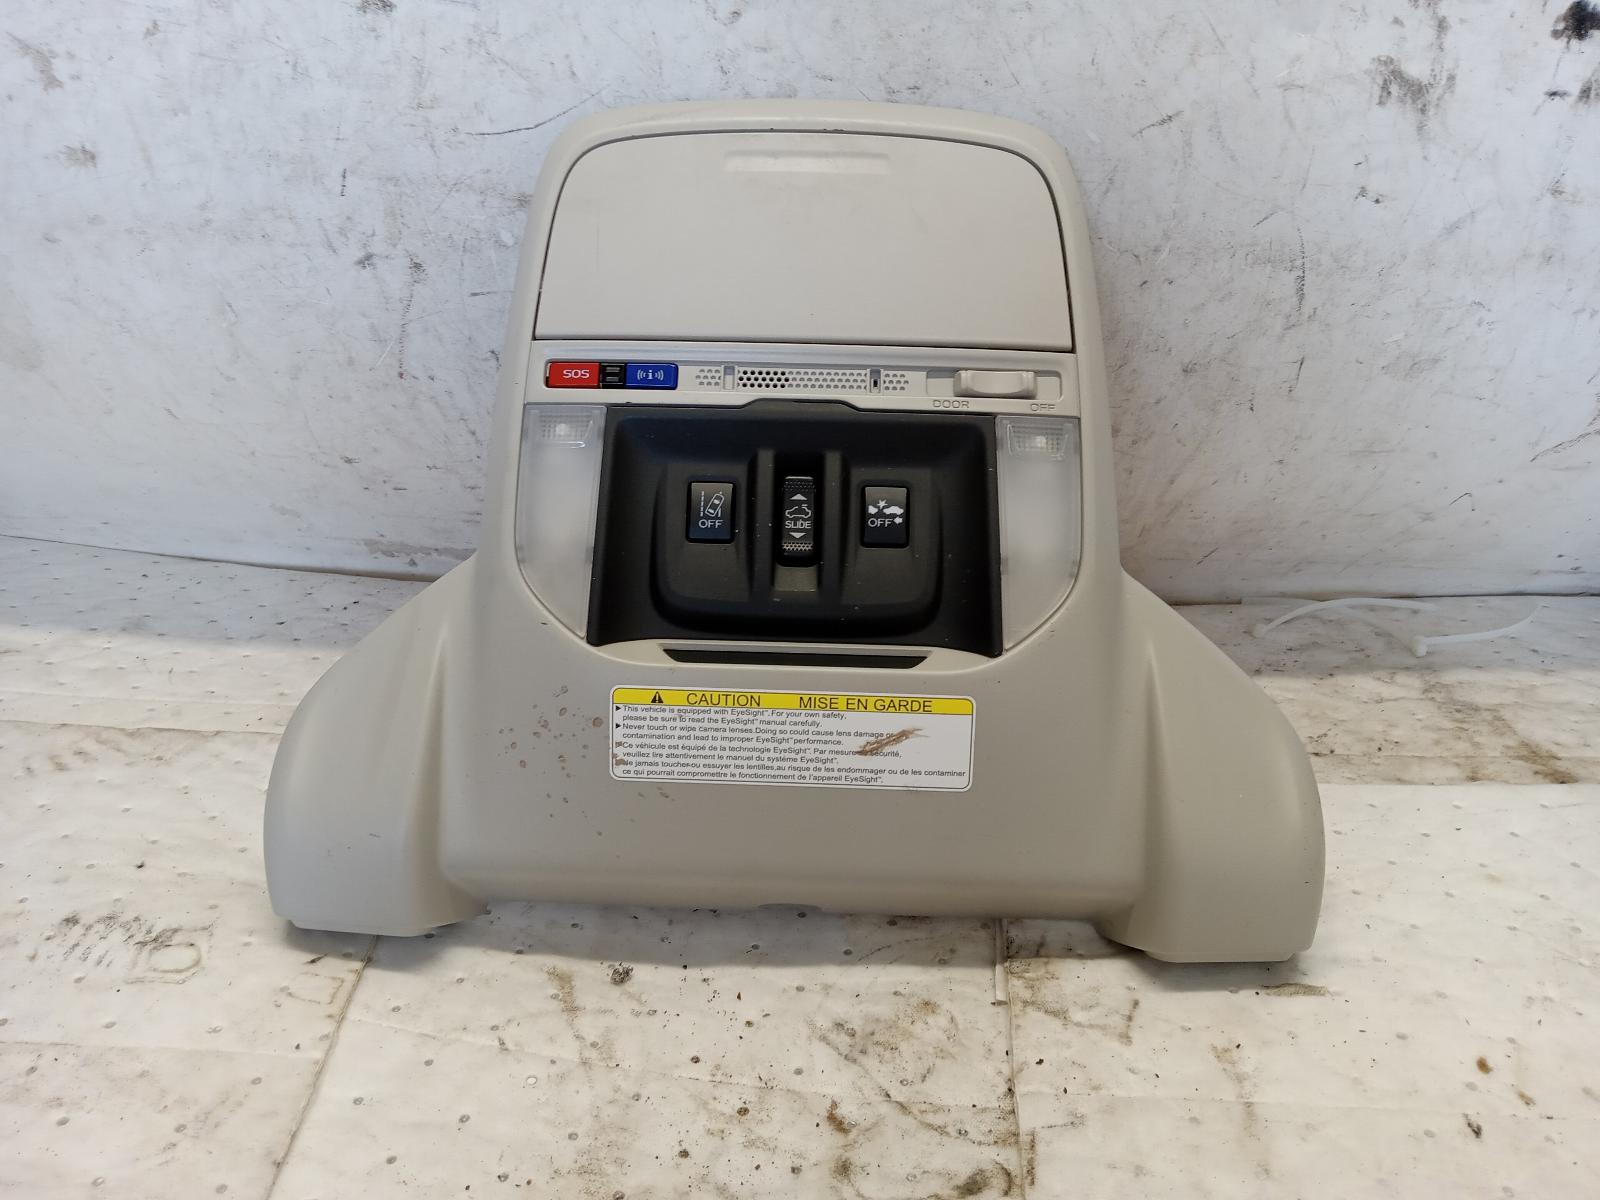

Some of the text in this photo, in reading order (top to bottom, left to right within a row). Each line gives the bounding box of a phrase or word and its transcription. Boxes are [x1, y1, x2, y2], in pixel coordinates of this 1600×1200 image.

[563, 369, 590, 379] SOS
[932, 399, 970, 409] DOOR
[1030, 403, 1056, 412] OFF
[698, 518, 723, 529] OFF
[785, 520, 811, 529] SLIDE
[868, 517, 892, 528] OFF
[687, 693, 932, 712] CAUTION MISE EN GARDE
[677, 707, 711, 715] equipped
[622, 714, 647, 722] please
[854, 730, 884, 739] damage
[681, 743, 706, 752] équipé
[729, 745, 771, 754] technologie
[788, 765, 810, 773] risque
[837, 766, 886, 776] endommager
[739, 772, 795, 780] fonctionnement
